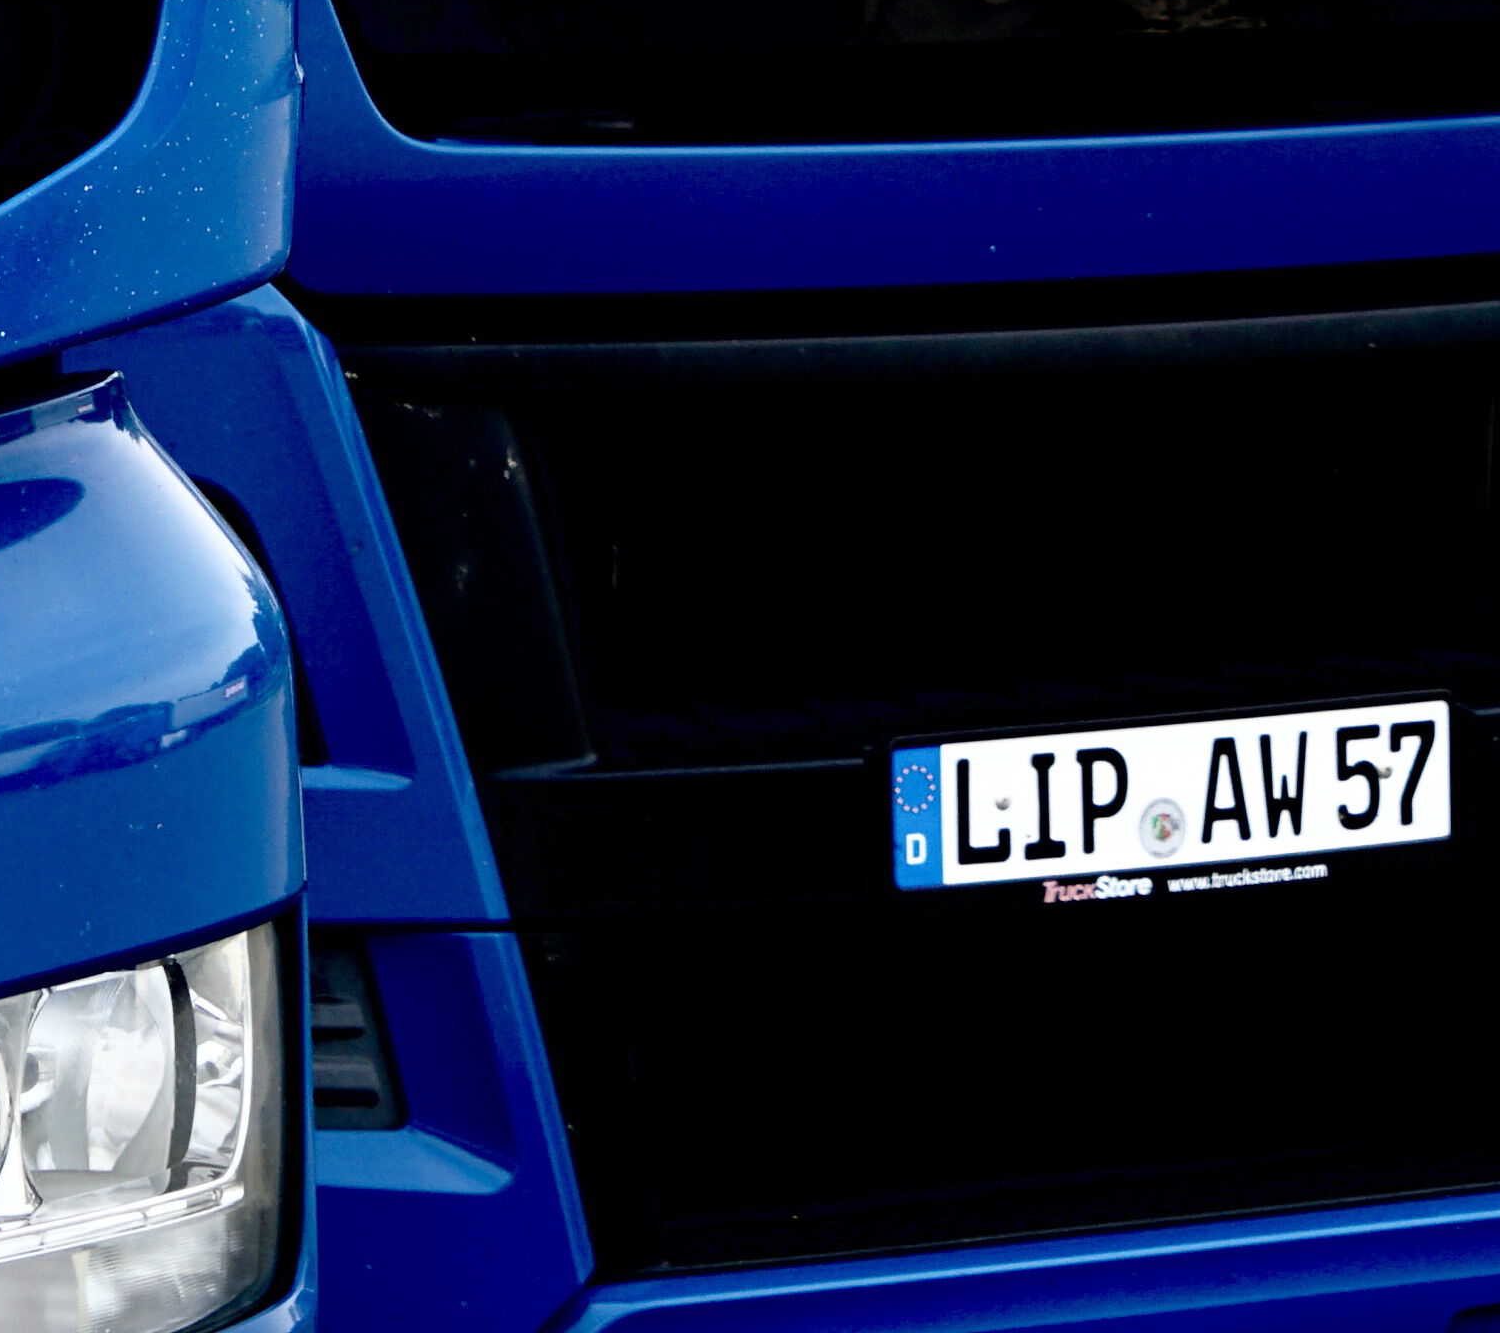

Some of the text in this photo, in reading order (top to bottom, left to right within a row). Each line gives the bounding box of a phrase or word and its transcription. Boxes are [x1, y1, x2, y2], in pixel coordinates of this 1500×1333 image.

[904, 719, 1437, 866] D LIP AW 57
[1166, 863, 1329, 893] www.truckstore.com
